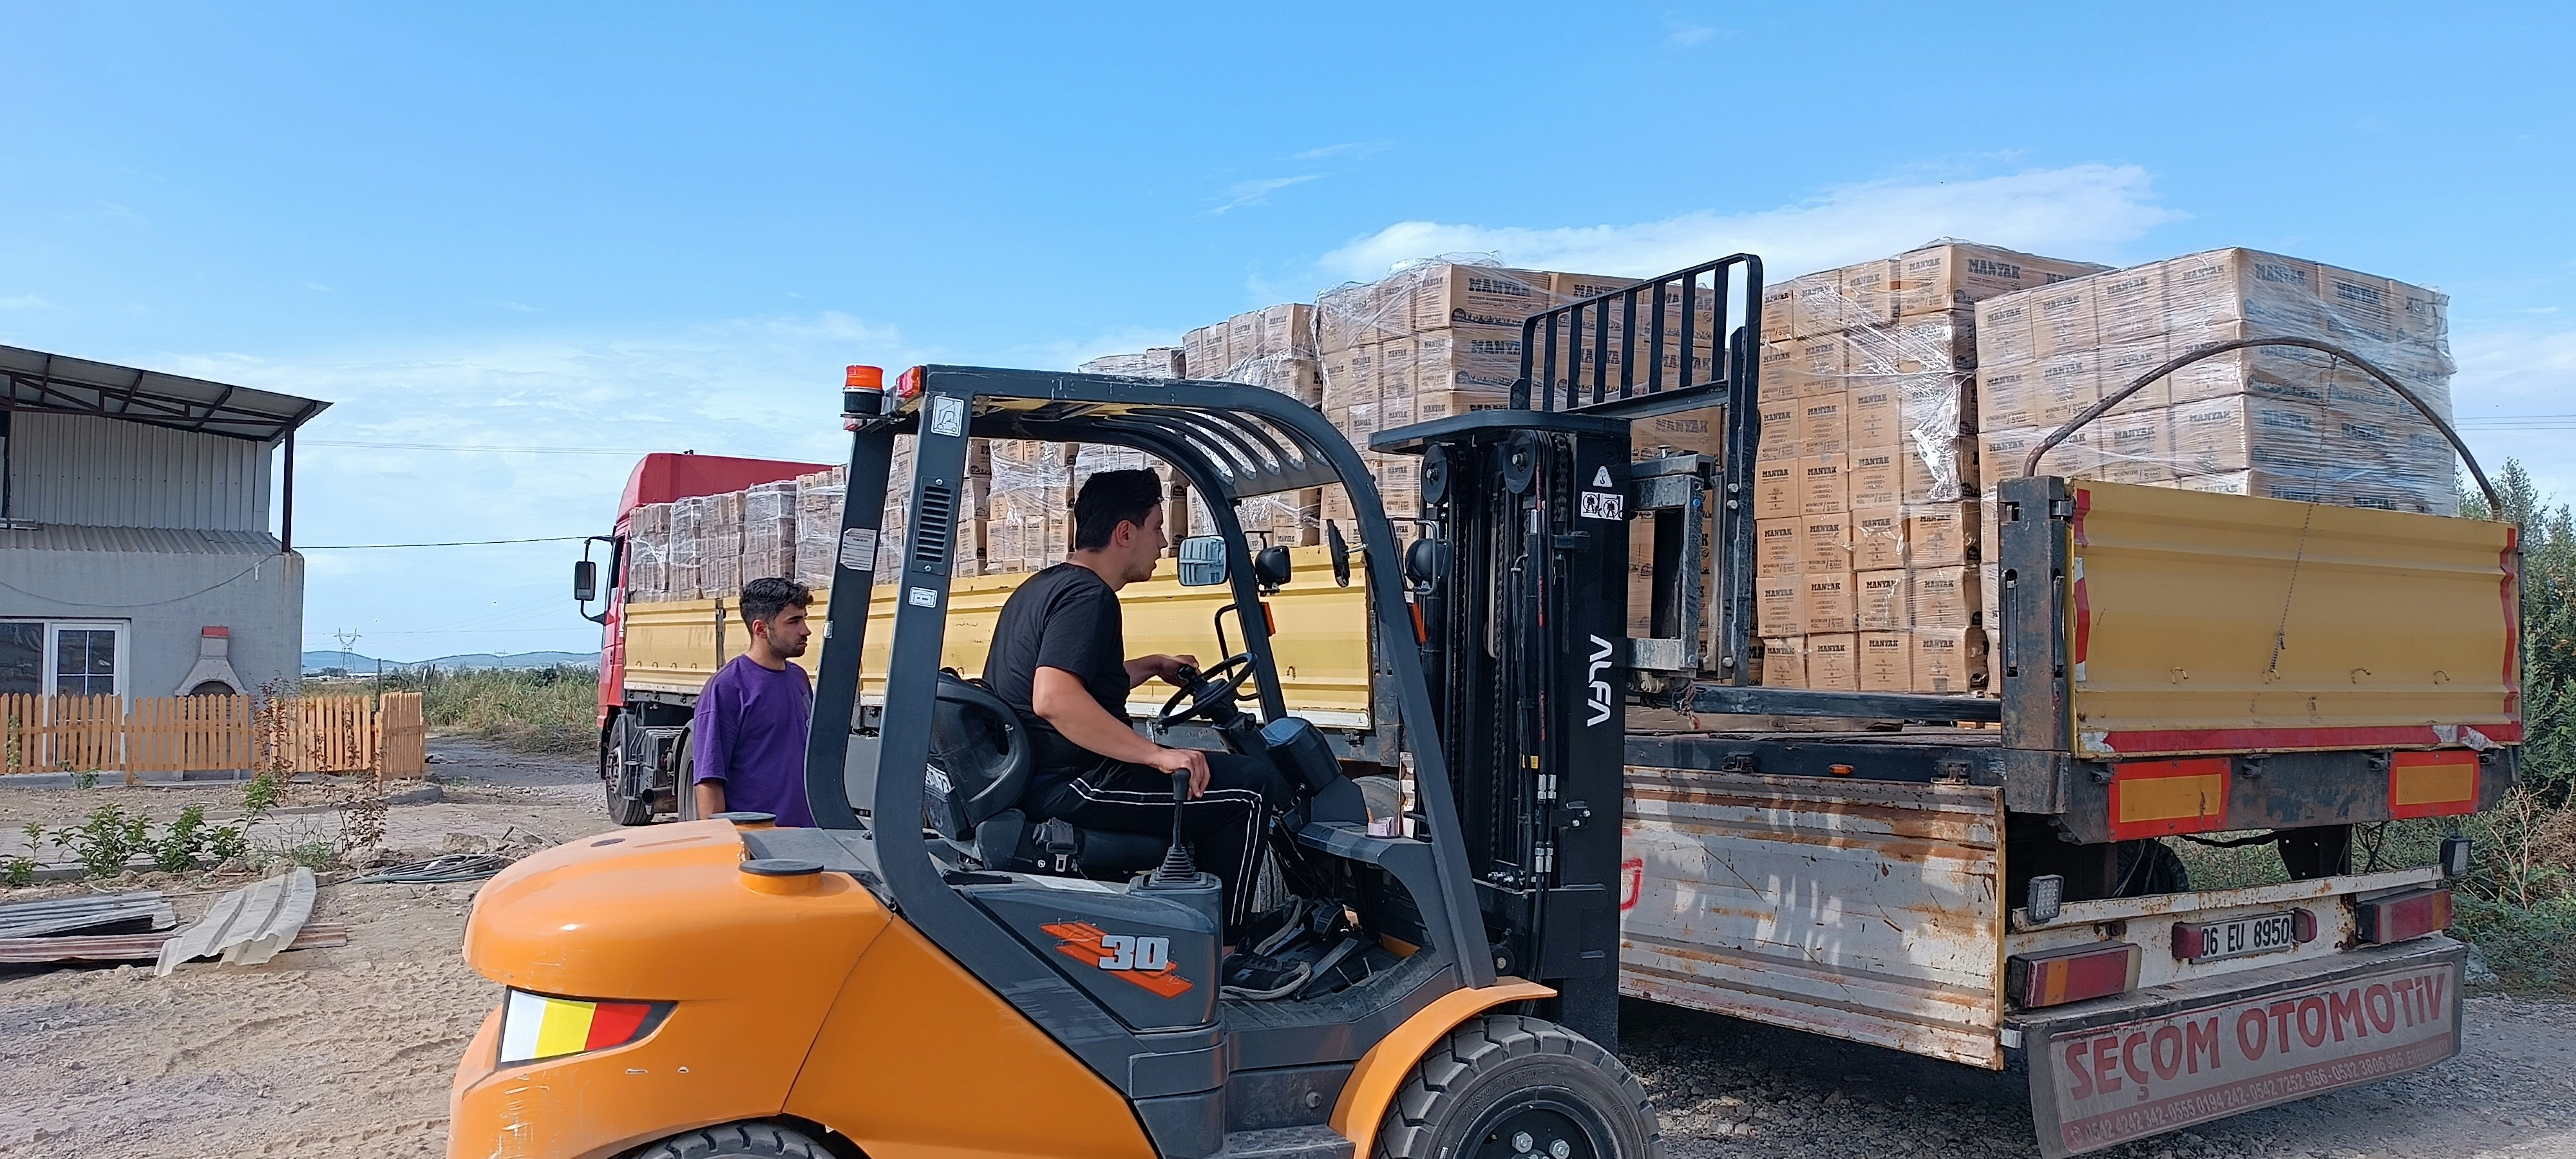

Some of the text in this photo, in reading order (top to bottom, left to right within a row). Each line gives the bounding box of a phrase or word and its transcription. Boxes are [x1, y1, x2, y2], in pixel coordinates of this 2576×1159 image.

[1909, 258, 1940, 270] MANYAK
[1967, 258, 2021, 279] MANYAK
[1858, 394, 1887, 404] MANYAK
[1808, 405, 1836, 415] MANYAK
[1764, 411, 1790, 421] MANYAK
[1859, 457, 1889, 466] MANYAK
[1762, 469, 1788, 477] MANYAK
[1808, 466, 1837, 475] MANYAK
[1862, 518, 1891, 527] MANYAK
[1765, 529, 1792, 537] MANYAK
[1587, 634, 1613, 727] ALFA
[2202, 918, 2290, 957] 06 EU 8950
[1099, 935, 1170, 970] 30
[2065, 972, 2446, 1101] SEÇOM OTOMOTİV
[2085, 1117, 2116, 1142] 0542
[2116, 1111, 2142, 1136] 4242
[2197, 1092, 2223, 1115] 0194
[2278, 1075, 2305, 1095] 7252
[2362, 1056, 2385, 1076] 3806
[2386, 1051, 2404, 1069] 905
